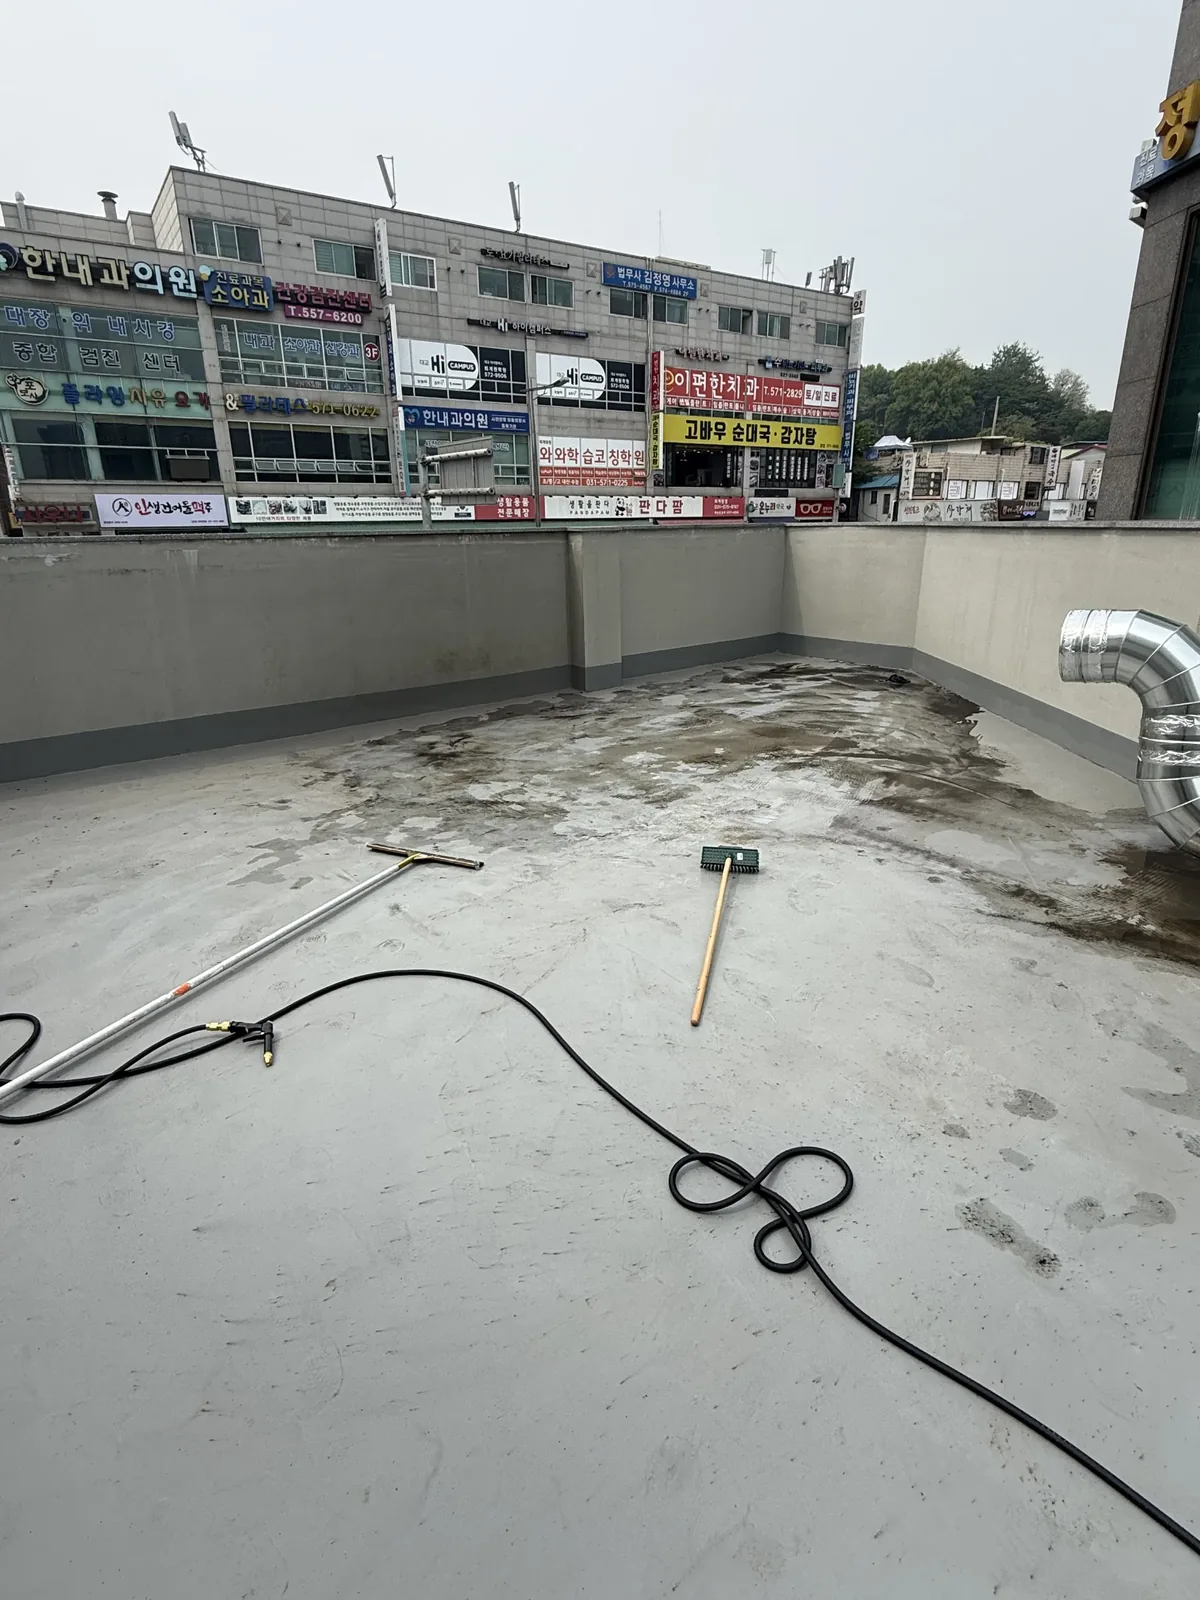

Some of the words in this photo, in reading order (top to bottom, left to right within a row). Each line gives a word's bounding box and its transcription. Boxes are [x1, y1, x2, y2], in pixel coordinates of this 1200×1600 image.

[18, 245, 198, 299] 한내과의원
[216, 272, 264, 288] 진료과목
[617, 266, 641, 282] 법무사
[644, 271, 671, 288] 김정영
[672, 277, 695, 290] 사무소
[211, 284, 270, 309] 소아과
[275, 281, 373, 312] 건강검진센터
[4, 305, 50, 330] 대장
[71, 311, 92, 333] 위
[106, 315, 175, 342] 내시경
[287, 305, 363, 324] T.557-6200
[498, 318, 509, 333] Hi
[513, 321, 552, 335] 하이캠퍼스
[243, 332, 276, 350] 내과
[284, 336, 322, 355] 소아과
[326, 340, 361, 359] 신경과
[365, 347, 378, 359] 3F
[12, 341, 57, 364] 종합
[79, 346, 122, 369] 검진
[142, 352, 180, 373] 센터
[431, 354, 445, 375] Hi
[449, 362, 475, 371] CAMPUS
[581, 374, 603, 383] CAMPUS
[674, 370, 760, 401] 이편한치과
[763, 385, 803, 399] T.571-2829
[805, 388, 822, 401] 토/일
[824, 390, 838, 402] 진료
[225, 392, 239, 411] &
[240, 394, 308, 416] 필라테스
[312, 402, 379, 419] 571-0622
[422, 409, 489, 429] 한내과의원
[685, 419, 727, 442] 고바우
[497, 497, 530, 508] 생활용품
[759, 500, 776, 515] 온누리
[497, 508, 530, 518] 전문매장
